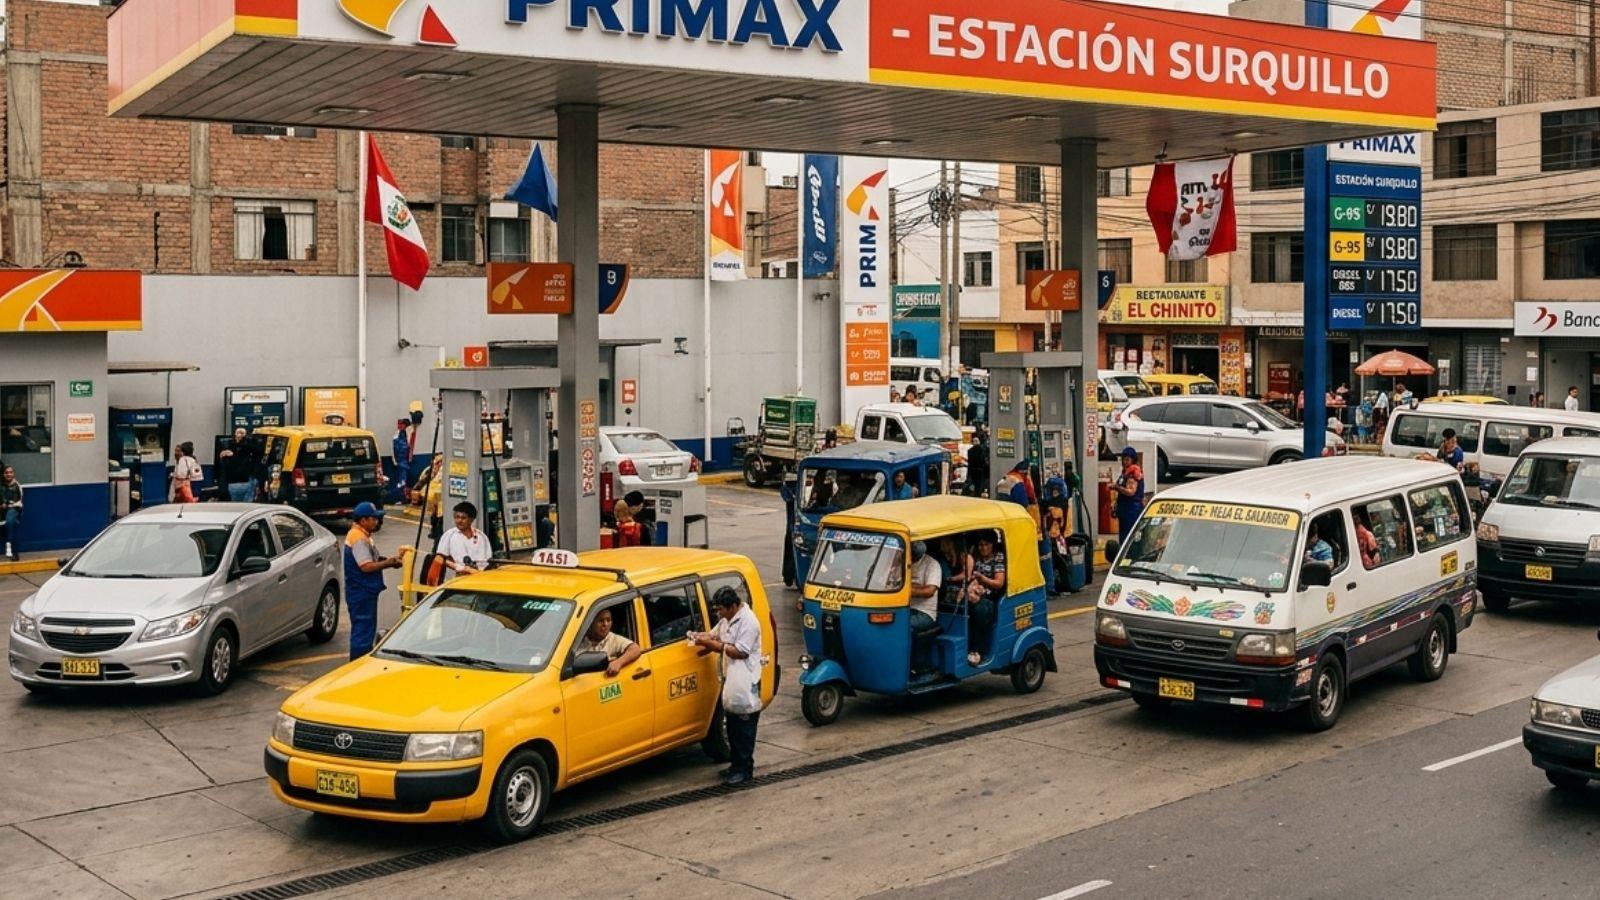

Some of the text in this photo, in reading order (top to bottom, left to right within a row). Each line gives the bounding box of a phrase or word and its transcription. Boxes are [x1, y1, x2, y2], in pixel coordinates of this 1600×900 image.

[928, 14, 1154, 76] ESTACIÓN
[1169, 41, 1389, 98] SURQUILLO
[859, 224, 876, 288] PRIM
[1334, 240, 1360, 254] G-95
[1128, 303, 1146, 318] EL
[1150, 302, 1216, 318] CHINITO
